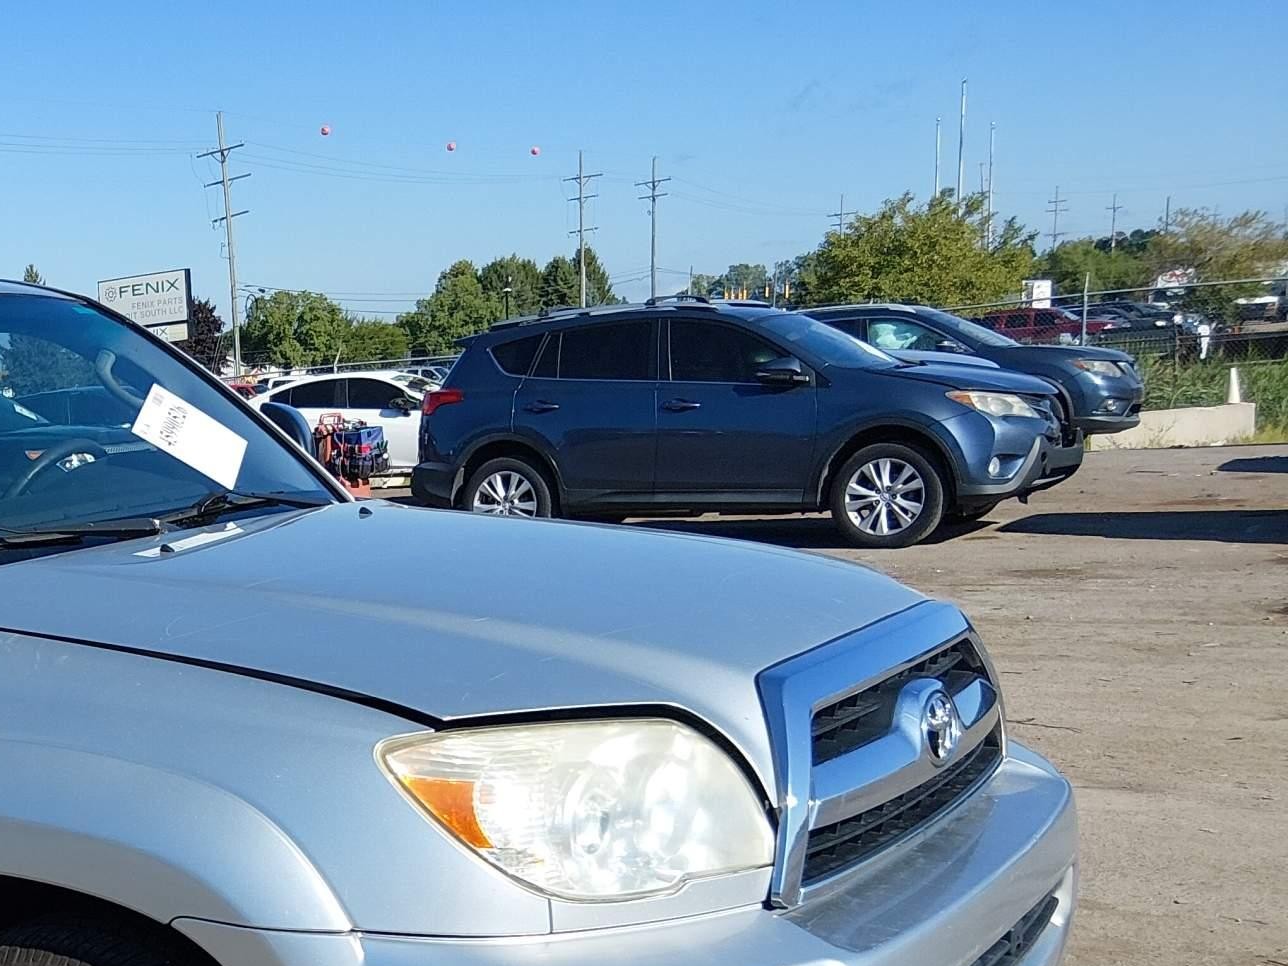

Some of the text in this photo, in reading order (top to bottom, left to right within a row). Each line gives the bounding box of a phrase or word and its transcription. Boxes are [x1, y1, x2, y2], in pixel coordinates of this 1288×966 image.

[119, 278, 179, 299] FENIX
[131, 296, 183, 311] FENIX PARTS
[140, 308, 167, 319] SOUTH
[169, 305, 184, 315] LLC
